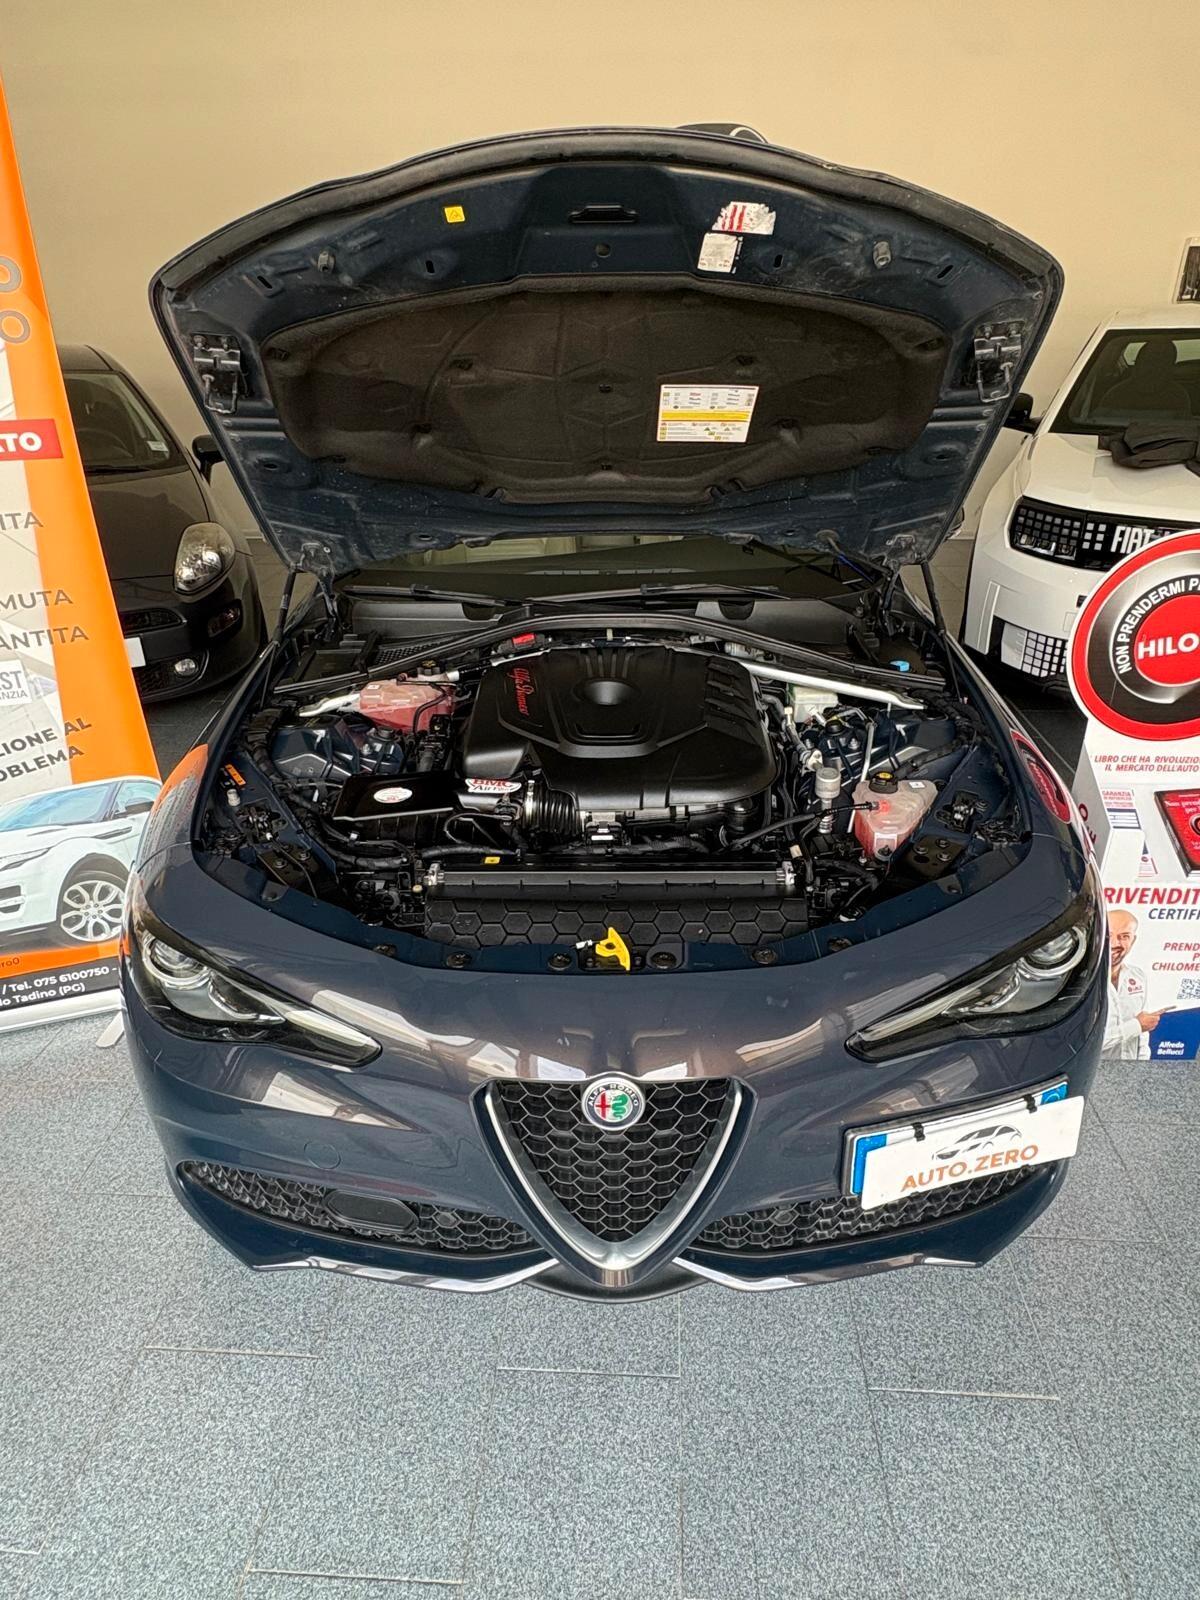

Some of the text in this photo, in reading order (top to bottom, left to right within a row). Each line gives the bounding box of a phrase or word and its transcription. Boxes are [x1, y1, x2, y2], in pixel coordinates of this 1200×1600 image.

[1110, 525, 1155, 554] FIAT
[1116, 578, 1200, 674] NON PRENDERMI P
[0, 671, 22, 691] ST
[0, 689, 28, 701] NZIA
[64, 717, 92, 737] AL
[1094, 755, 1120, 763] LIBRO
[1120, 755, 1137, 763] CHE
[1154, 756, 1200, 764] RIVOLUZIO
[1115, 764, 1155, 772] MERCATO
[1156, 765, 1199, 773] DELL'AUTO
[9, 980, 33, 992] Tel.
[34, 976, 58, 988] 075
[59, 966, 110, 983] 6100750
[13, 990, 57, 1003] Tadino
[59, 982, 86, 996] (PG)
[1157, 1048, 1184, 1056] Bellucci
[1159, 1041, 1185, 1049] Alfredo
[588, 1083, 640, 1107] ALFA ROMEO
[900, 1144, 1039, 1192] AUTO.ZERO
